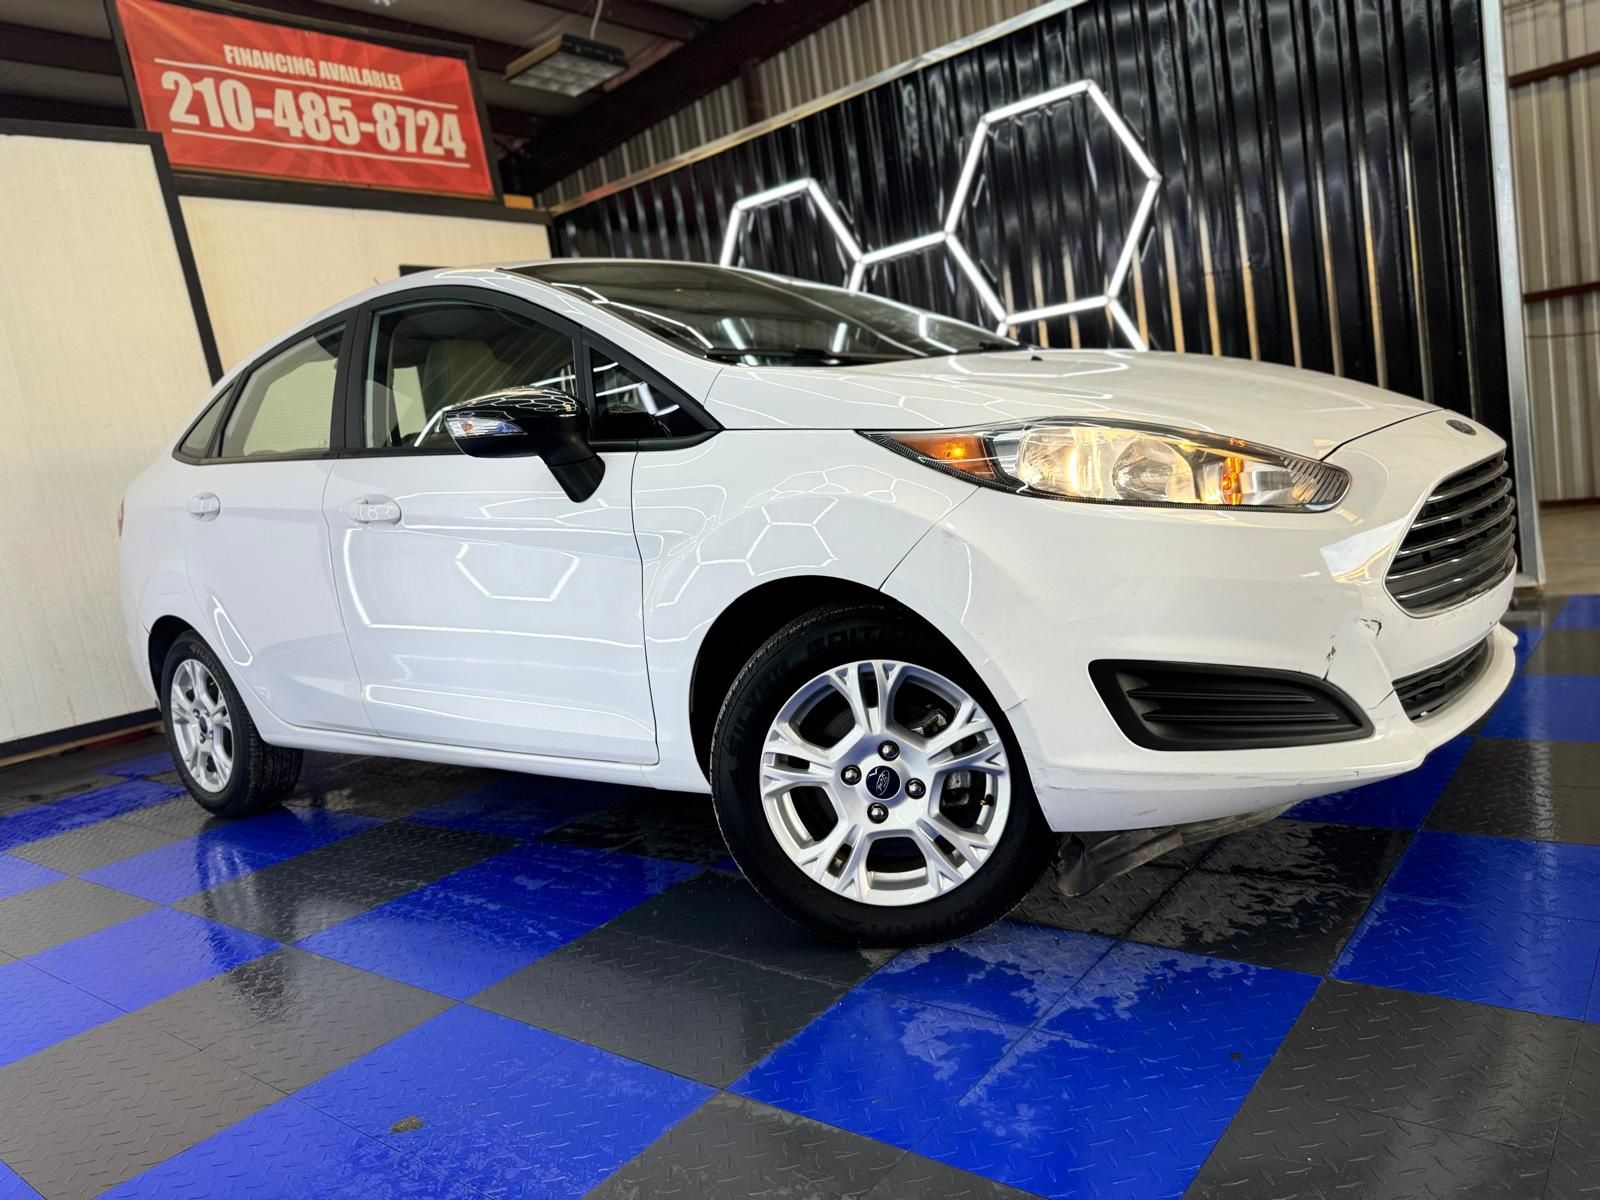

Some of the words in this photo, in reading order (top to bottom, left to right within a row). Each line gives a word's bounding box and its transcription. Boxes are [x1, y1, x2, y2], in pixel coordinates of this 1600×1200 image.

[223, 44, 316, 77] FINANCING
[319, 60, 404, 91] AVAILABLE!
[161, 71, 466, 158] 210-485-8724
